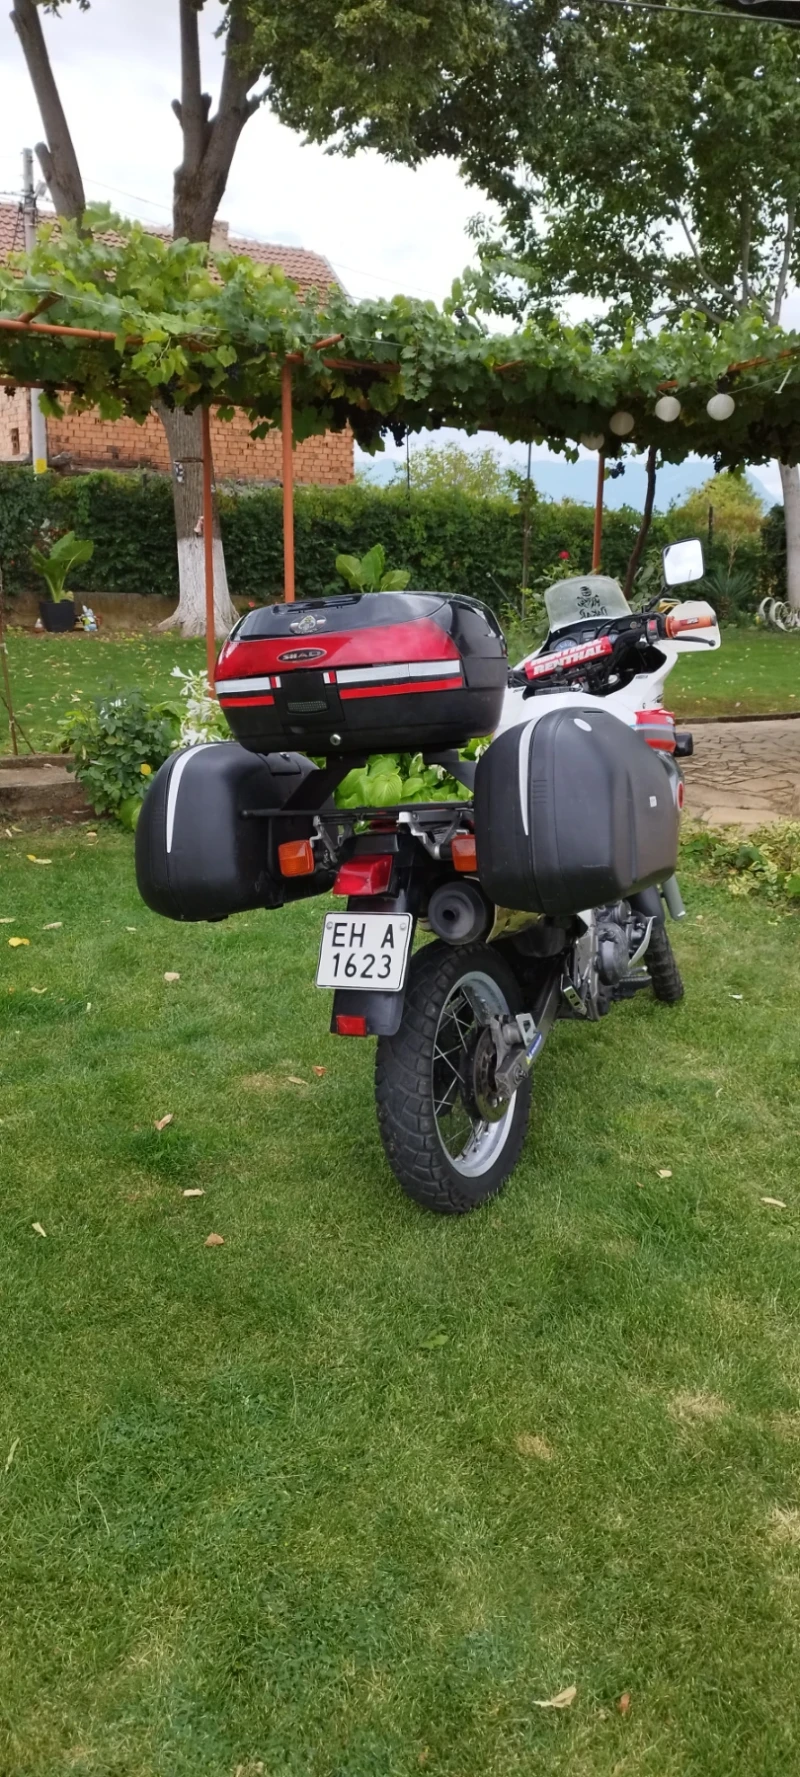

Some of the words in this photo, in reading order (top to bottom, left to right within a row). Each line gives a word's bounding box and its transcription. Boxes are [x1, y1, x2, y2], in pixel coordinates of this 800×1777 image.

[282, 650, 321, 660] SHAD
[533, 645, 605, 676] RENTHAL
[332, 922, 366, 948] EH
[380, 923, 395, 949] A
[333, 953, 392, 979] 1623
